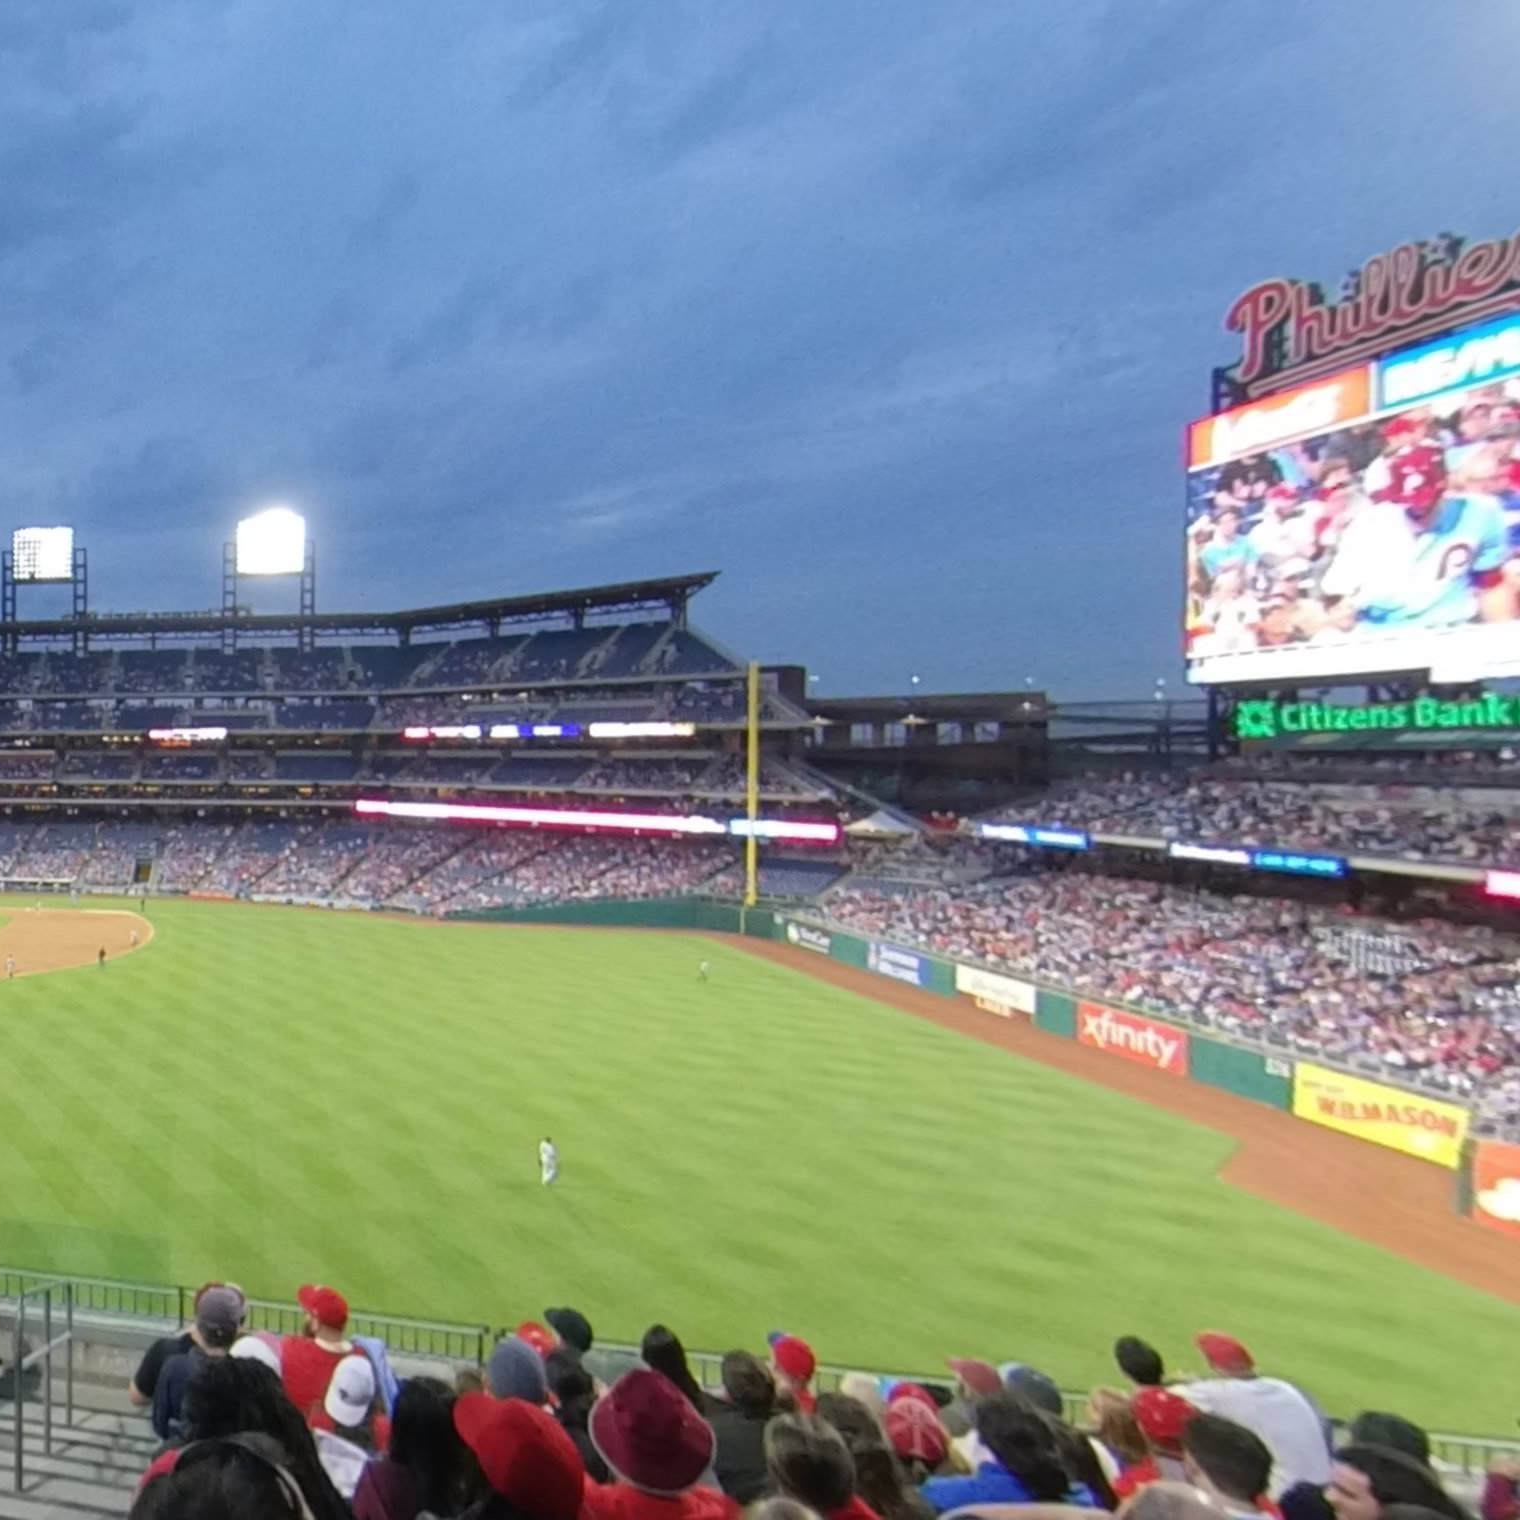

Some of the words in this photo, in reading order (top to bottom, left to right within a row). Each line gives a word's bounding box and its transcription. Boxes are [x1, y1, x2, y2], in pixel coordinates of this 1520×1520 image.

[1281, 703, 1408, 731] Citizens
[1415, 692, 1514, 728] Bank
[1083, 1010, 1178, 1069] xfinity
